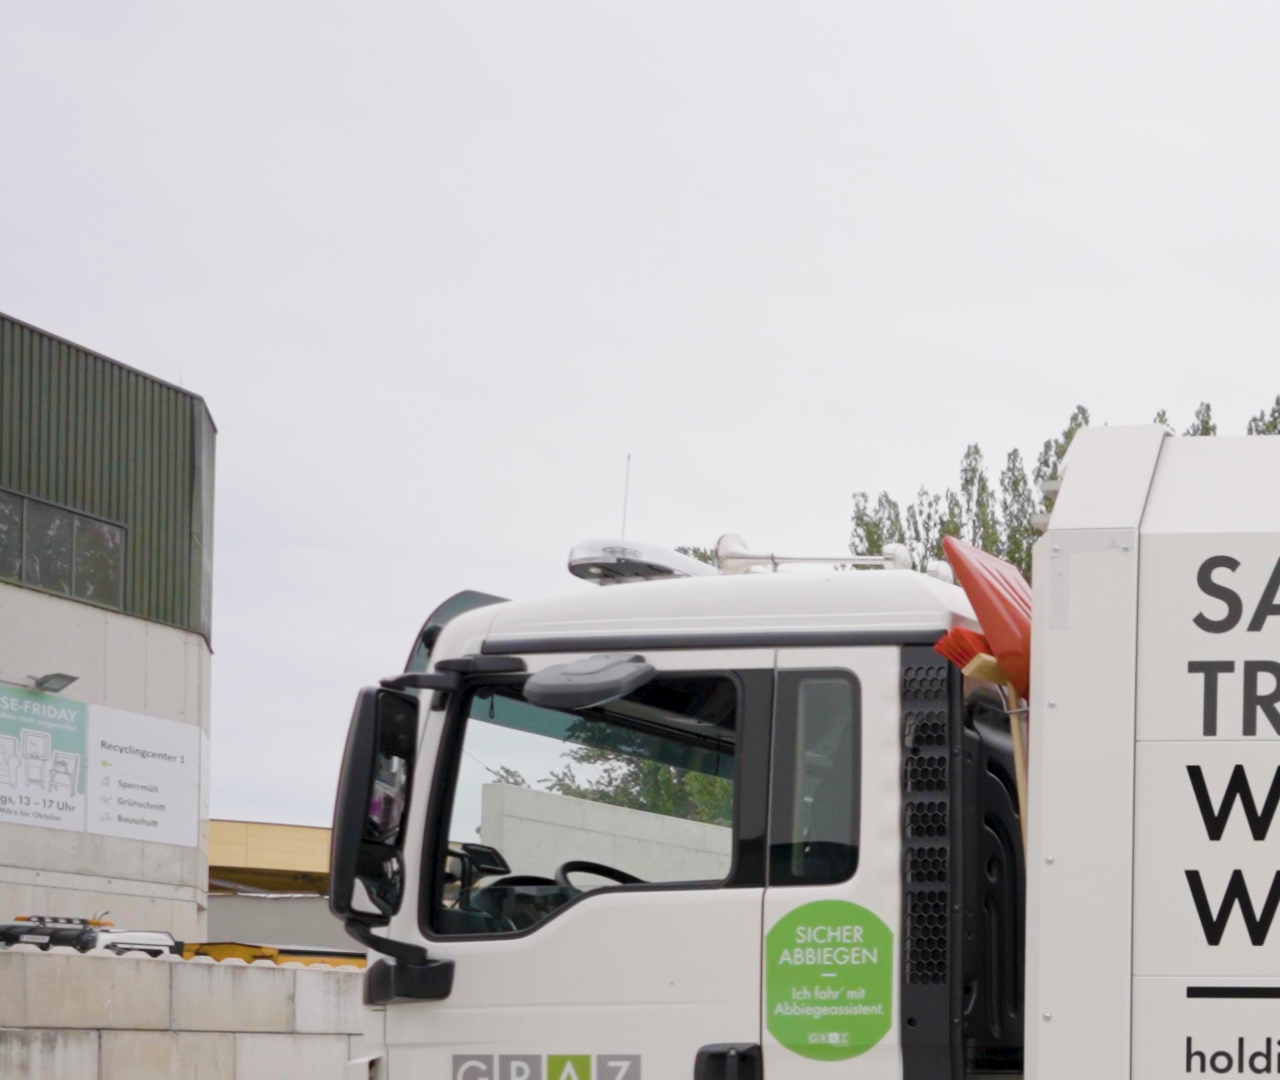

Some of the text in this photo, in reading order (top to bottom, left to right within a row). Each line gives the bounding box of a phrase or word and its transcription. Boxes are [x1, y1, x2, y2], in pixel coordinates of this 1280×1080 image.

[101, 740, 185, 764] Recyclingcenter 1
[117, 779, 159, 793] Sperrmüll
[19, 795, 30, 806] 13
[43, 799, 54, 808] 17
[57, 801, 75, 812] Uhr
[117, 796, 166, 811] Grünschnitt
[117, 814, 159, 828] Bauschutt
[795, 926, 864, 944] SICHER
[778, 947, 878, 966] ABBIEGEN
[792, 987, 811, 1000] Ich
[847, 987, 865, 1000] mit
[774, 1003, 885, 1019] Abbiegeassistent.
